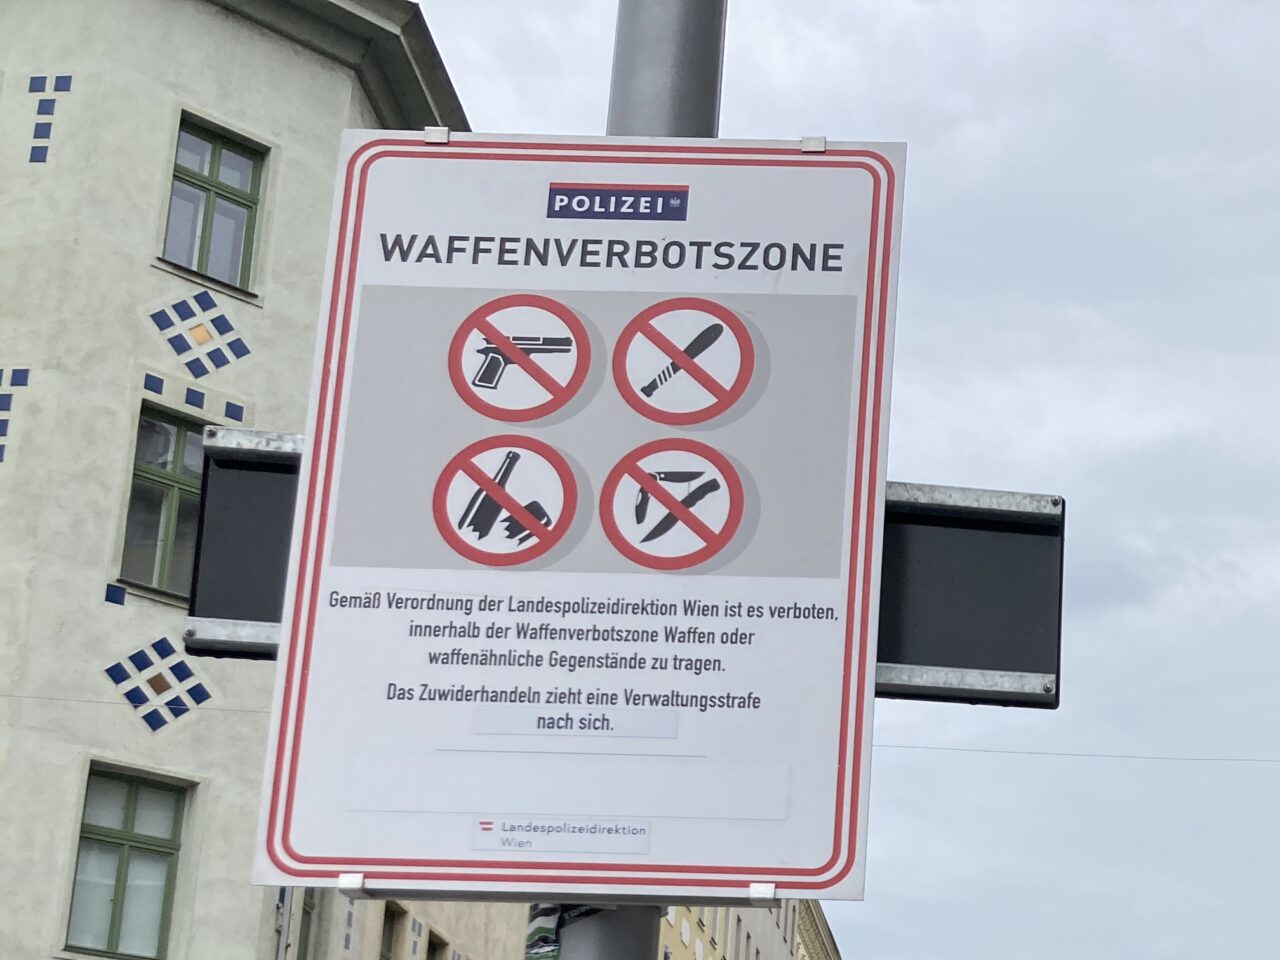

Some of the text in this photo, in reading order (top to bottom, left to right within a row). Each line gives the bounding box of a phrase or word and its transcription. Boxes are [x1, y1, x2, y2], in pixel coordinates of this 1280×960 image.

[554, 194, 664, 214] POLIZEI
[379, 232, 845, 273] WAFFENVERBOTSZONE
[329, 590, 839, 622] Gemäß Verordnung der Landespolizeidirektion Wien ist es verboten,
[408, 619, 756, 645] innerhalb der Waffenverbotszone Waffen oder
[428, 648, 726, 675] waffenähnliche Gegenstände zu tragen.
[387, 682, 761, 713] Das Zuwiderhandeln zieht eine Verwaltungsstrafe
[536, 712, 615, 731] nach sich.
[501, 821, 647, 836] Landespolizeidirektion
[501, 837, 533, 849] Wien
